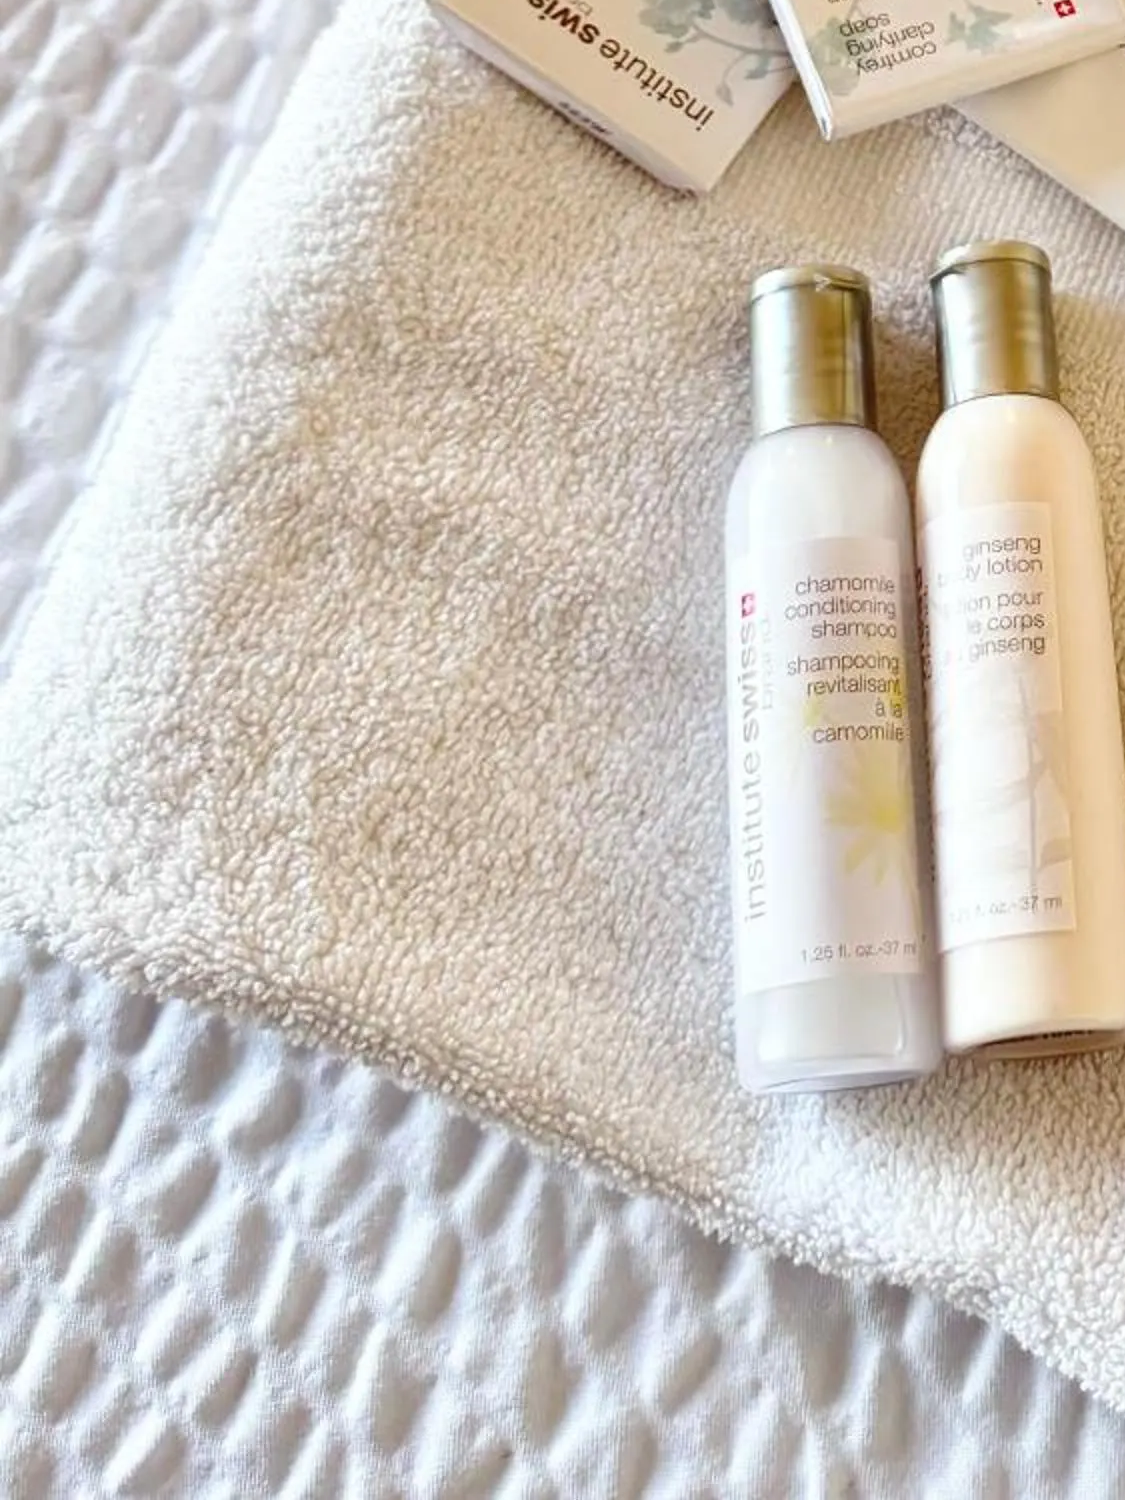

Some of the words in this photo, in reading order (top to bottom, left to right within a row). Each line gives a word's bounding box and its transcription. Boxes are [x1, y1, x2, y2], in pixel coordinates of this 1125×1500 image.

[839, 13, 891, 38] soap
[845, 21, 936, 57] clarifying
[857, 40, 937, 76] comfrey
[600, 38, 716, 131] institute
[963, 534, 1041, 562] ginseng
[987, 555, 1043, 576] lotion
[784, 595, 897, 621] conditioning
[997, 591, 1043, 613] pour
[811, 619, 898, 640] shampoo
[987, 612, 1045, 632] corps
[969, 634, 1045, 662] ginseng
[787, 652, 900, 676] shampooing
[738, 620, 759, 744] swiss
[875, 696, 886, 717] à
[812, 722, 906, 743] camomile
[741, 750, 767, 923] institute
